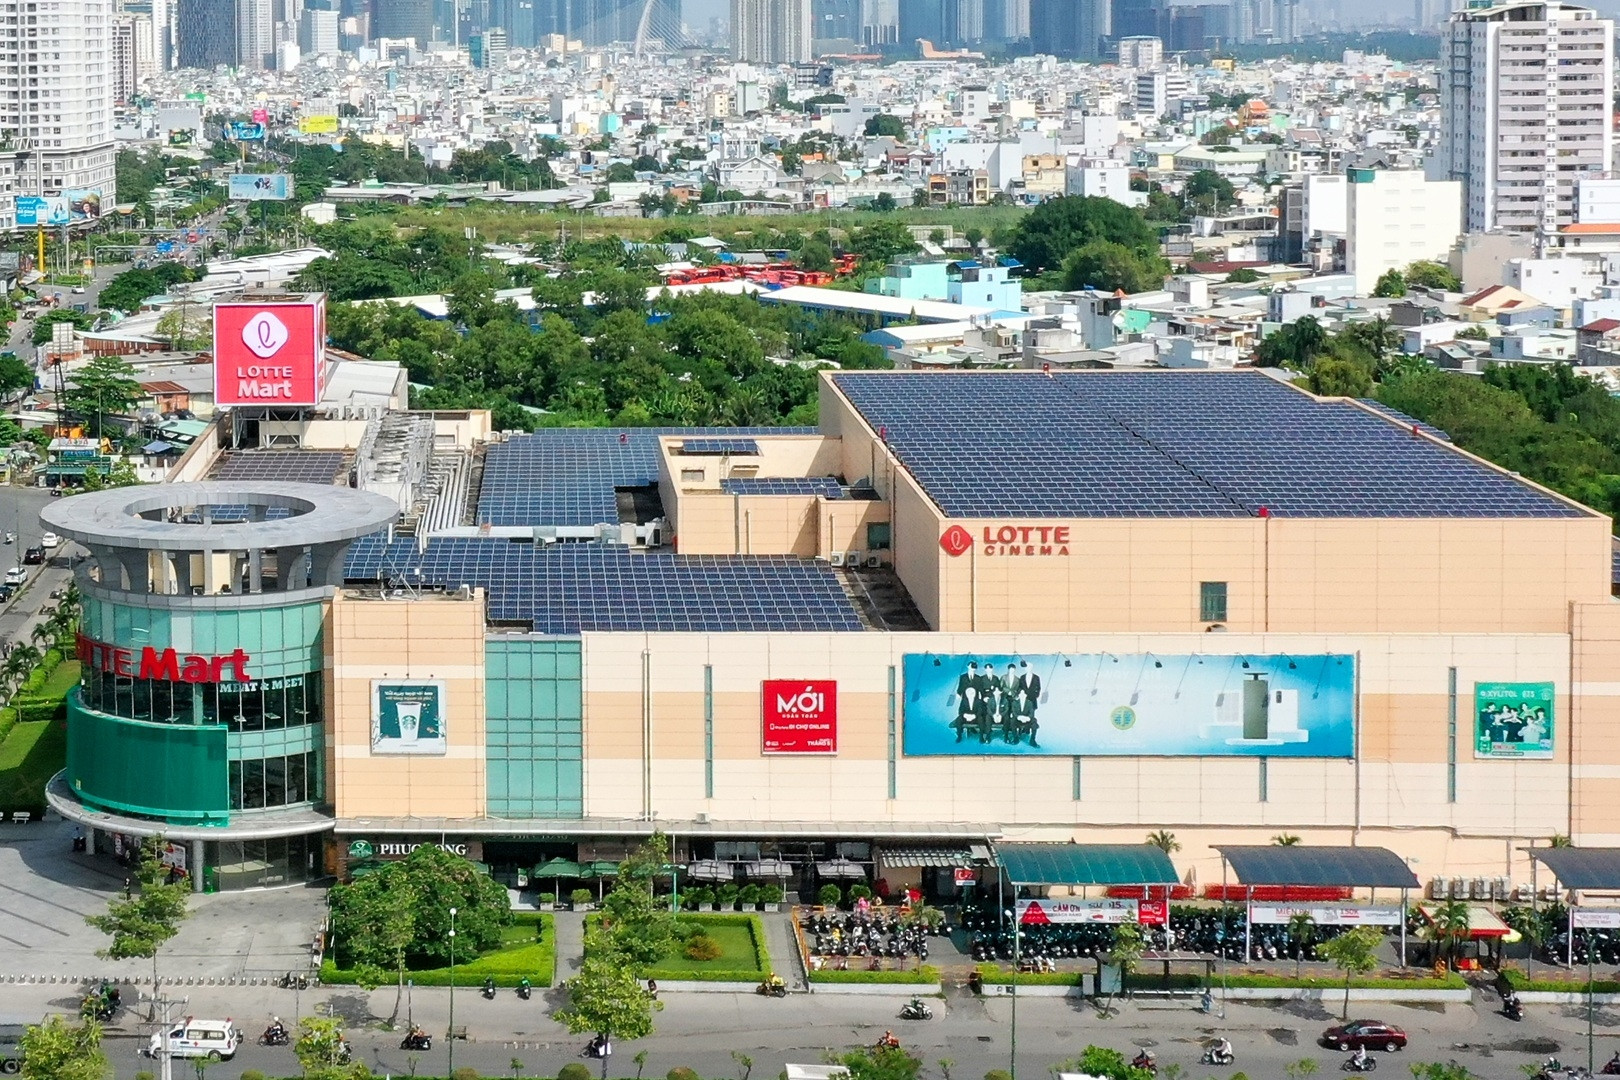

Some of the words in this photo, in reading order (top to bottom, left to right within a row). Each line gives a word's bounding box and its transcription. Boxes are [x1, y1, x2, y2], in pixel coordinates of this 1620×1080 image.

[237, 365, 292, 378] LOTTE
[237, 380, 292, 398] Mart
[983, 525, 1070, 544] LOTTE
[983, 545, 1070, 556] CINEMA
[75, 632, 134, 678] TTE
[139, 646, 250, 683] Mart
[219, 681, 258, 694] MEAT
[260, 682, 270, 691] &
[271, 677, 303, 691] MEET
[777, 685, 824, 713] MỚI
